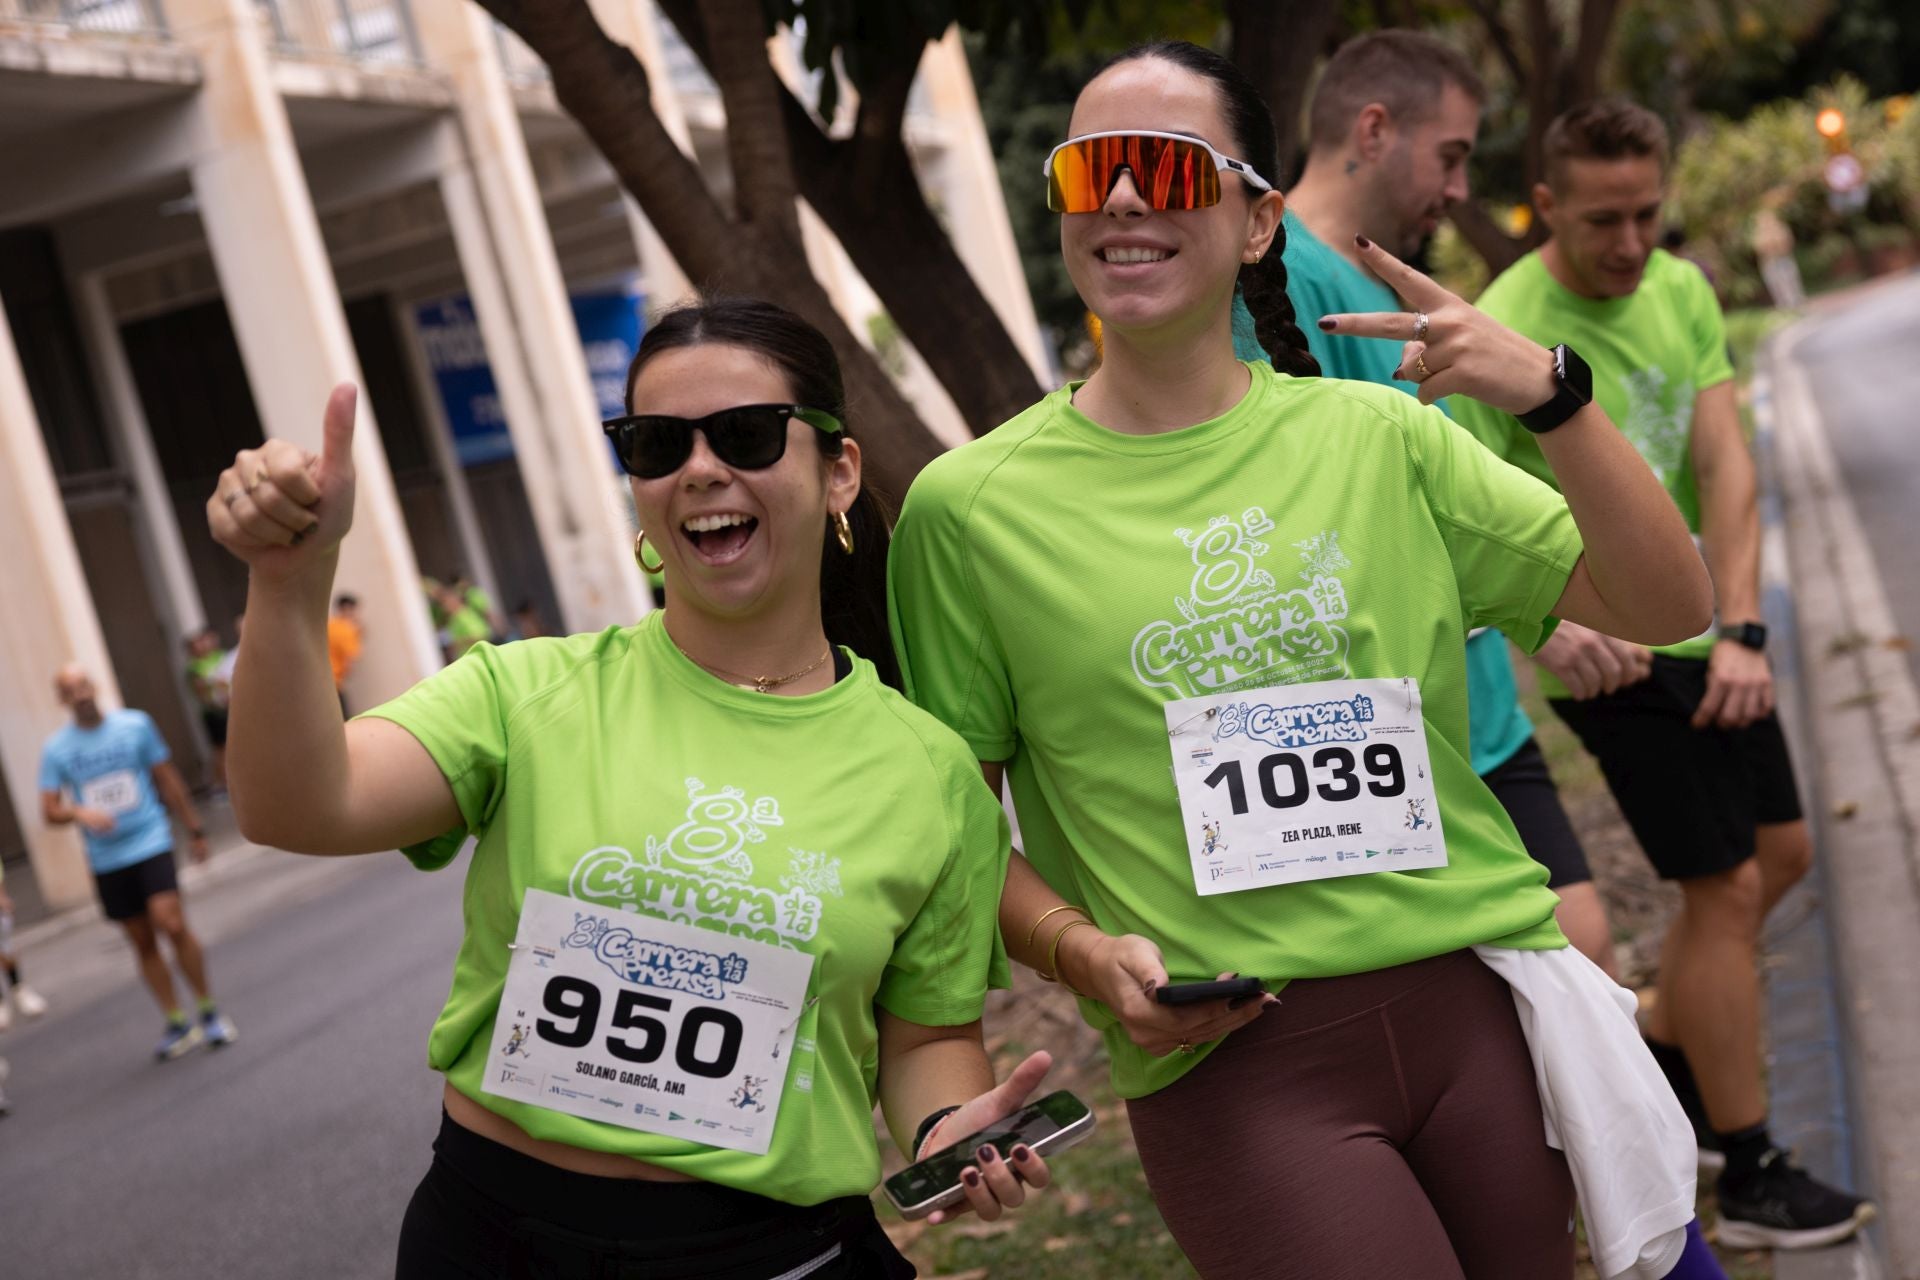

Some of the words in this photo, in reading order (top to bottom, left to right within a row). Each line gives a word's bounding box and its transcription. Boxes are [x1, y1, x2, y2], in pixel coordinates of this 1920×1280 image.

[1318, 596, 1345, 615] la
[1143, 593, 1316, 676] Carrera
[1313, 580, 1338, 598] de
[1184, 621, 1335, 693] Prensa
[1251, 700, 1355, 733] Carrera
[1354, 694, 1370, 709] de
[1355, 706, 1372, 720] la
[1275, 721, 1365, 746] Prensa
[1203, 743, 1406, 816] 1039
[1281, 827, 1300, 843] ZEA
[1302, 826, 1335, 841] PLAZA,
[1337, 822, 1362, 837] IRENE
[581, 856, 777, 926] Carrera
[784, 892, 815, 914] de
[785, 910, 812, 935] la
[601, 933, 720, 977] Carrera
[722, 954, 744, 969] de
[623, 960, 724, 999] Prensa
[516, 1009, 525, 1019] M
[536, 975, 744, 1079] 950
[575, 1060, 617, 1081] SOLANO
[618, 1070, 661, 1092] GARCÍA,
[664, 1080, 686, 1096] ANA
